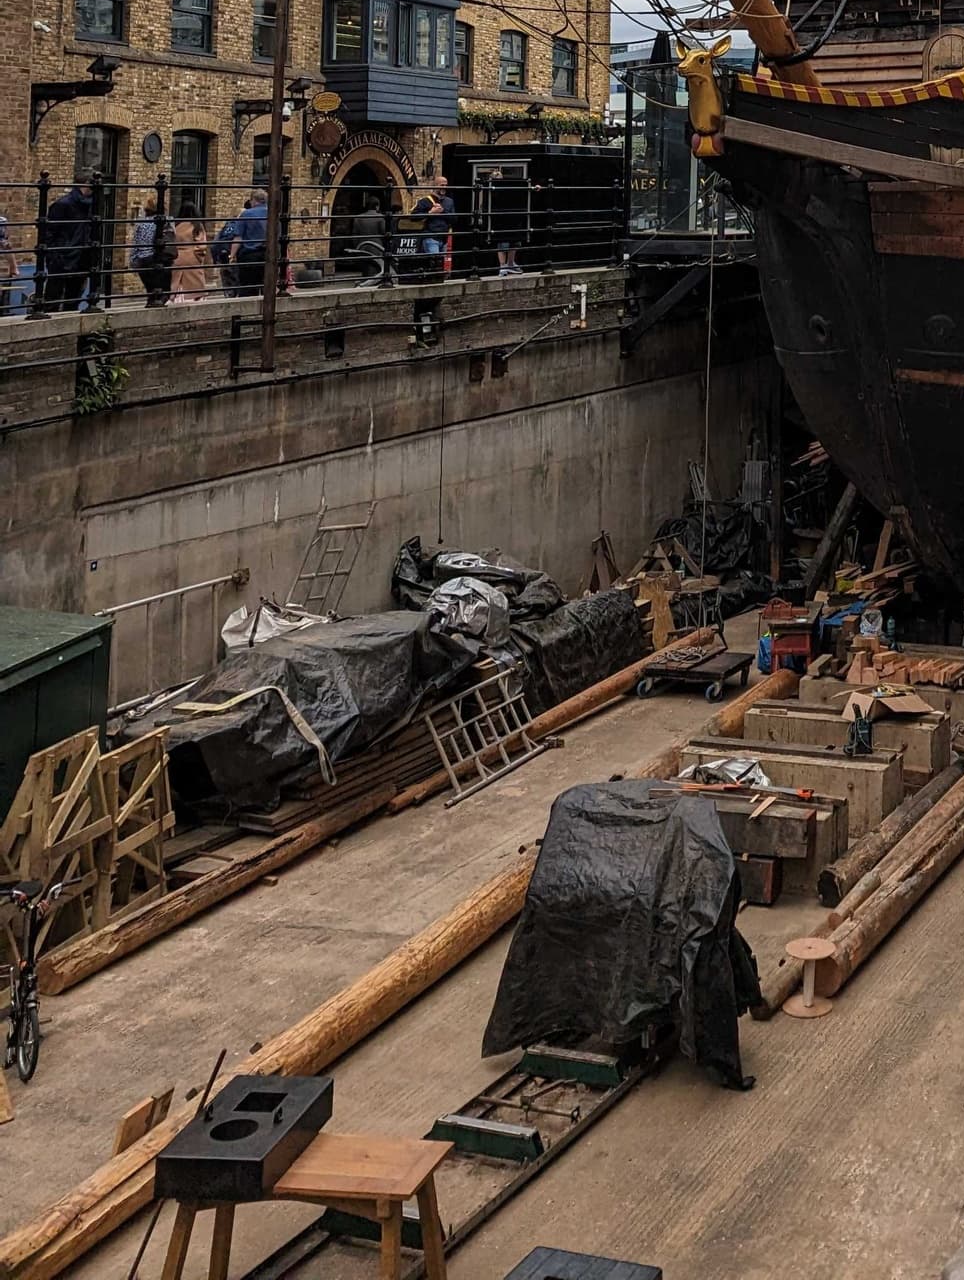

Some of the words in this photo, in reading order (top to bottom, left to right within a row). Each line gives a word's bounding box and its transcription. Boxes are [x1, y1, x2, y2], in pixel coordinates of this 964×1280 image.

[348, 132, 402, 159] THAMESIDE
[401, 155, 415, 180] INN
[400, 238, 417, 248] PIE
